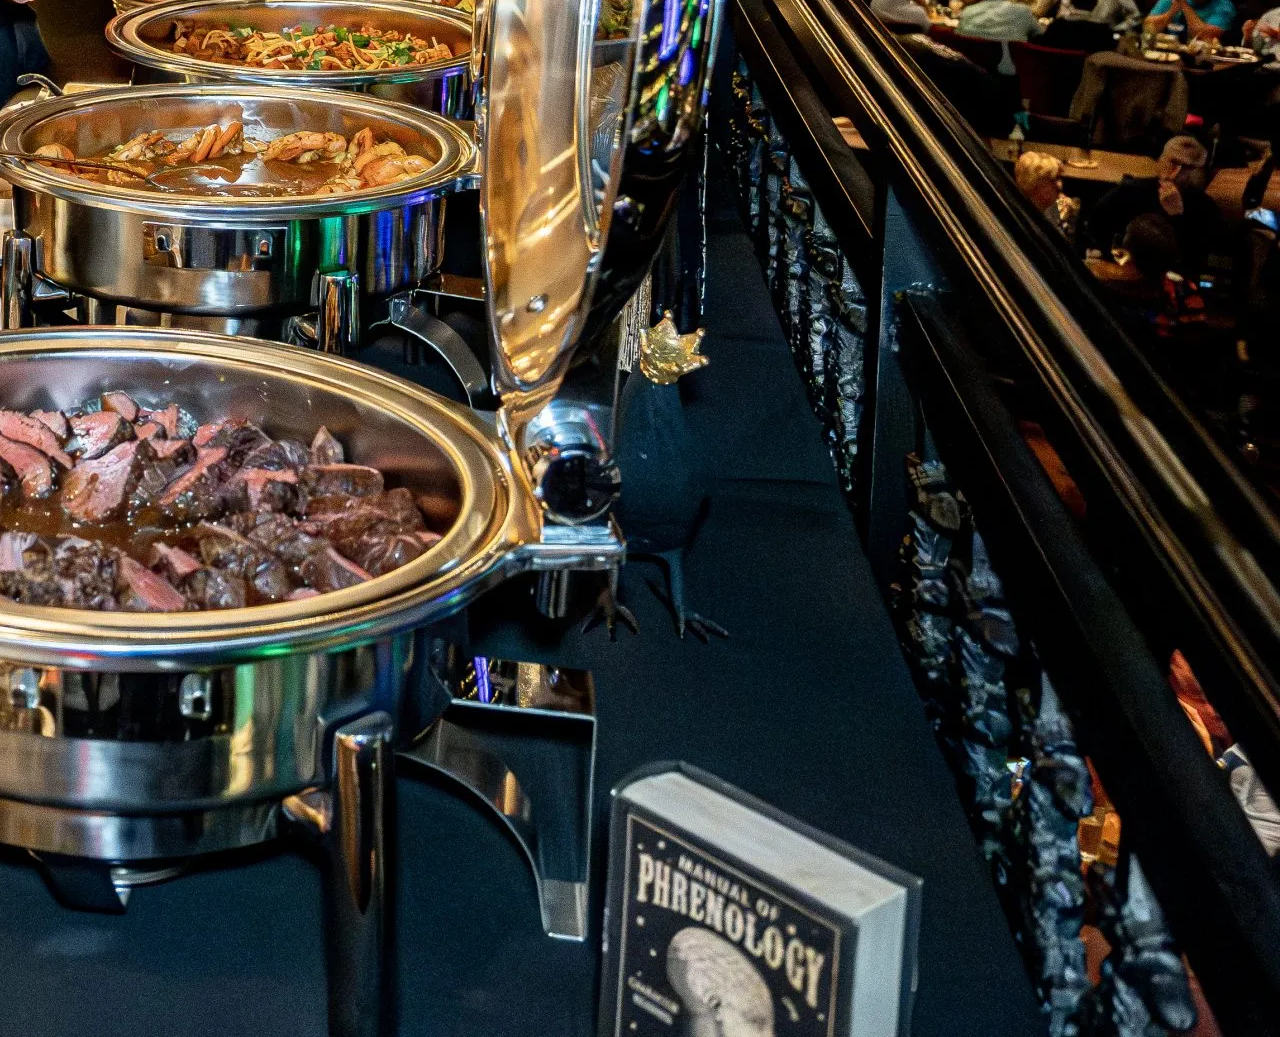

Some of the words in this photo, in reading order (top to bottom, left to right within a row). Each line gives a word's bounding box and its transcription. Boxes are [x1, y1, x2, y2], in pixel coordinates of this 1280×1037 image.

[636, 853, 825, 1008] PHRENOLOGY
[678, 855, 749, 909] MANUAL
[755, 898, 781, 922] OF
